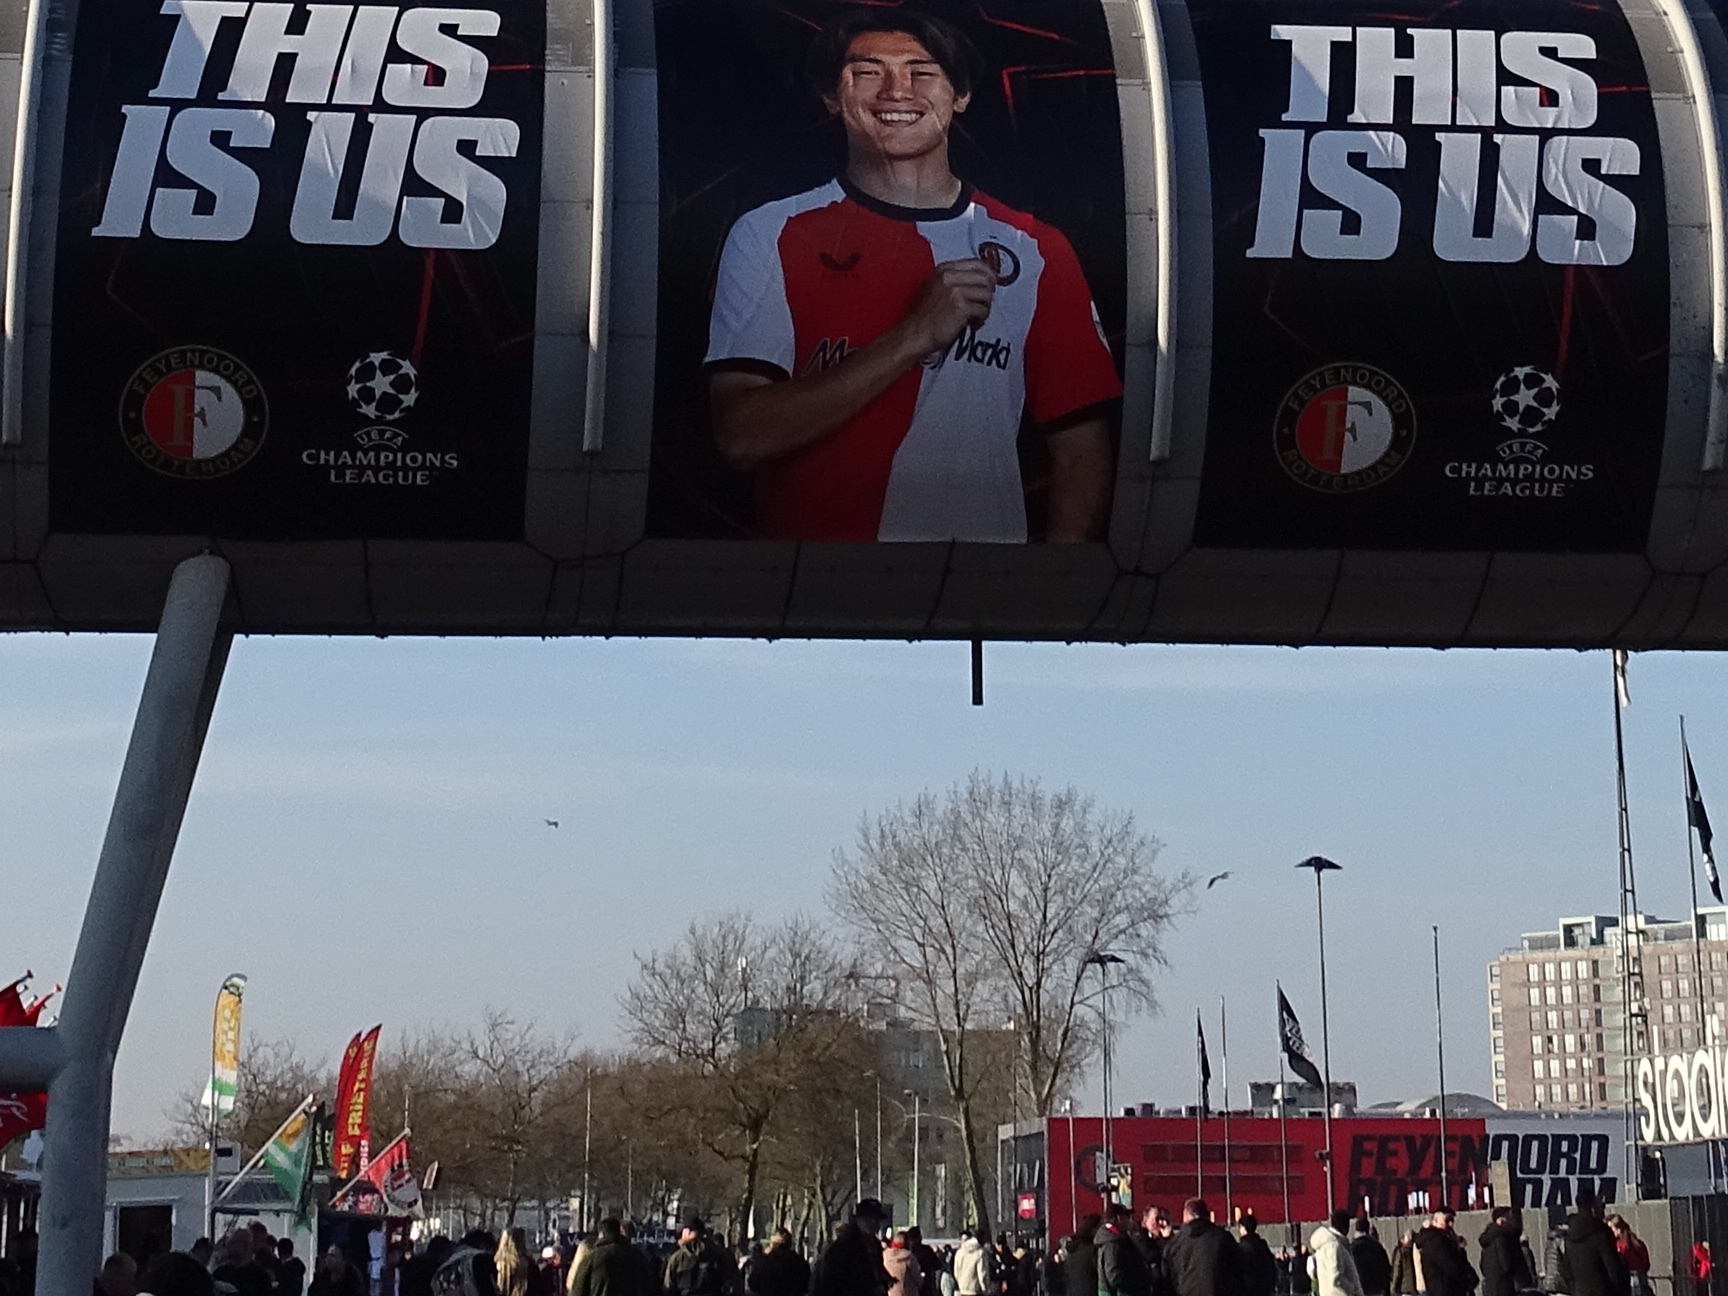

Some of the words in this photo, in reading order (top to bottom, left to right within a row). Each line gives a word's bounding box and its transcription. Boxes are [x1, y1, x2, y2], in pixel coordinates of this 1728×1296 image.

[147, 0, 501, 109] THIS
[1271, 24, 1598, 129] THIS
[90, 105, 275, 242] IS
[289, 111, 521, 250] US
[1246, 128, 1407, 260] IS
[1432, 132, 1641, 267] US
[132, 351, 259, 401] FEYENOORD
[1287, 368, 1407, 415] FEYENOORD
[131, 432, 257, 477] ROTTERDAM
[301, 449, 459, 469] CHAMPIONS
[354, 429, 405, 448] UEFA
[1497, 441, 1547, 461] UEFA
[329, 468, 432, 486] LEAGUE
[1445, 462, 1595, 481] CHAMPIONS
[1469, 481, 1566, 498] LEAGUE
[1349, 1133, 1610, 1177] FEYENOORD
